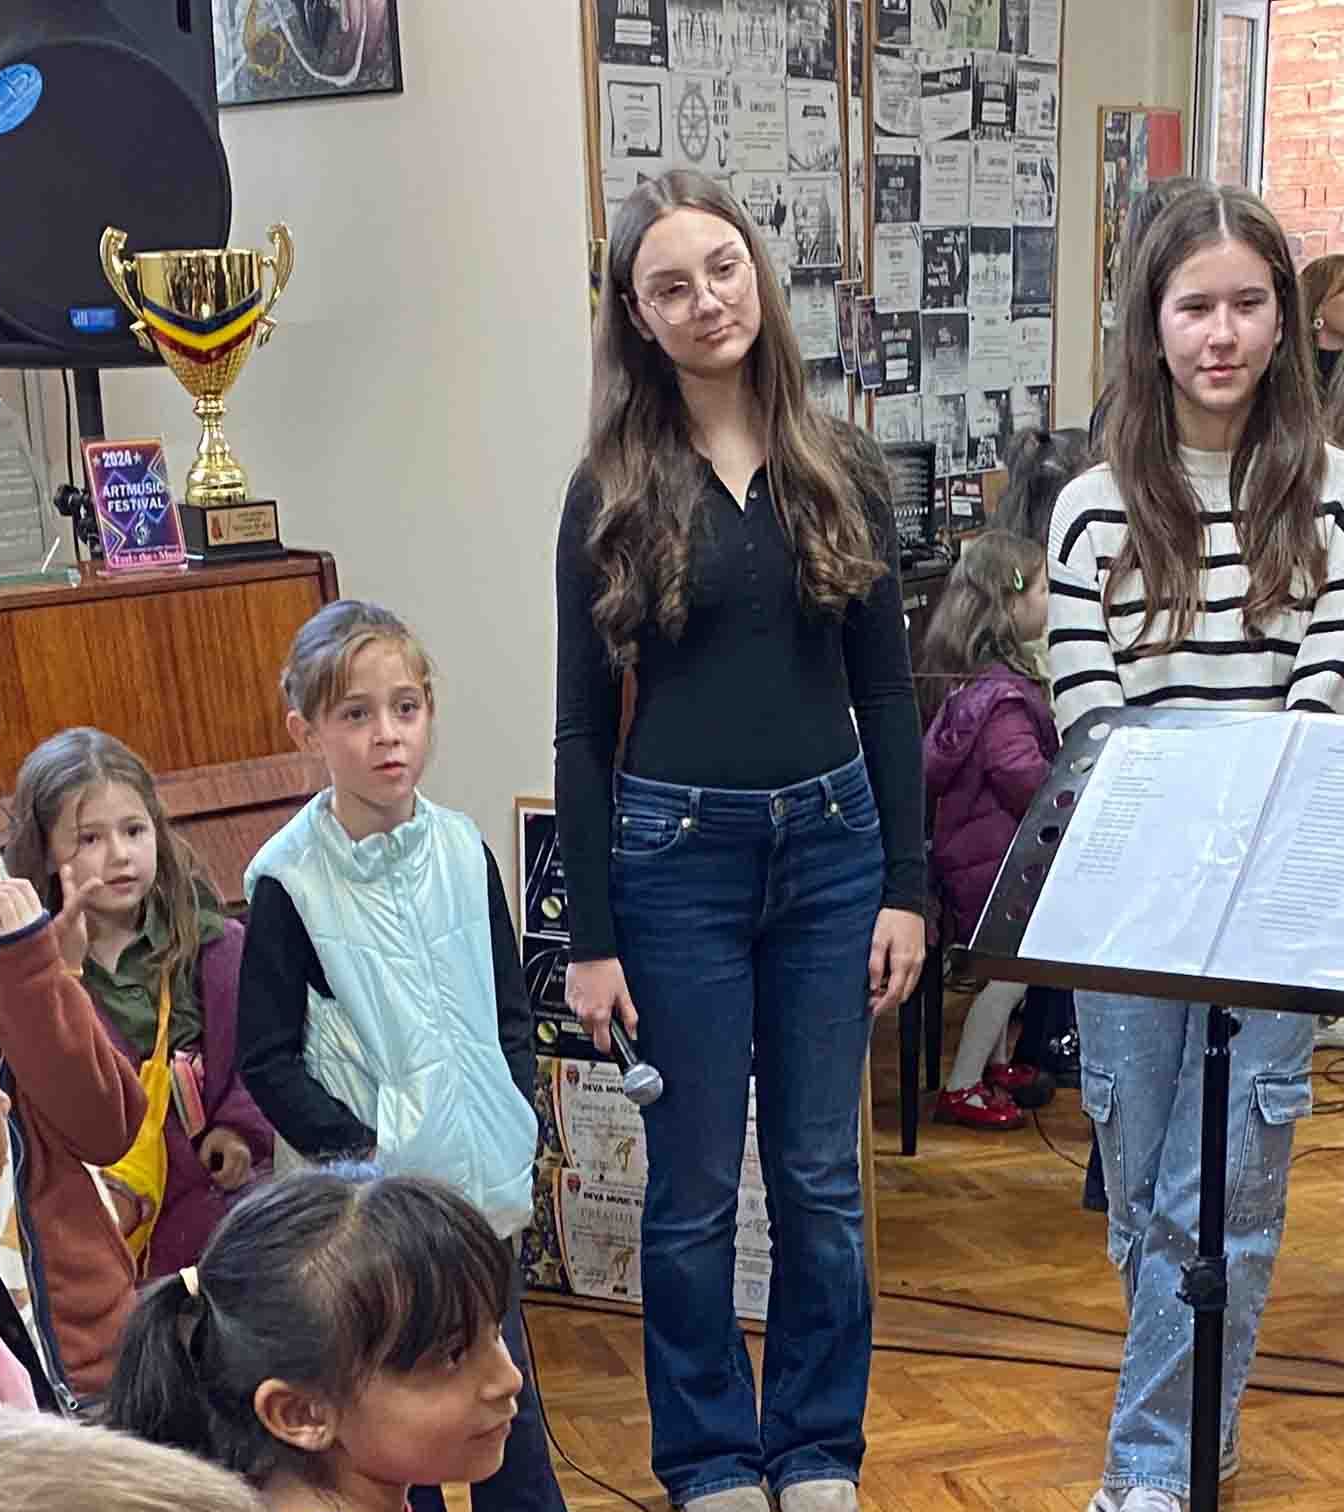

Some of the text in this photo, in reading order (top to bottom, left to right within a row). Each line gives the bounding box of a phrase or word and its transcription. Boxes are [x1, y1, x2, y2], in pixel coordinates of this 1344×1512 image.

[102, 450, 133, 467] 2024
[103, 480, 165, 498] ARTMUSIC
[108, 497, 164, 513] FESTIVAL
